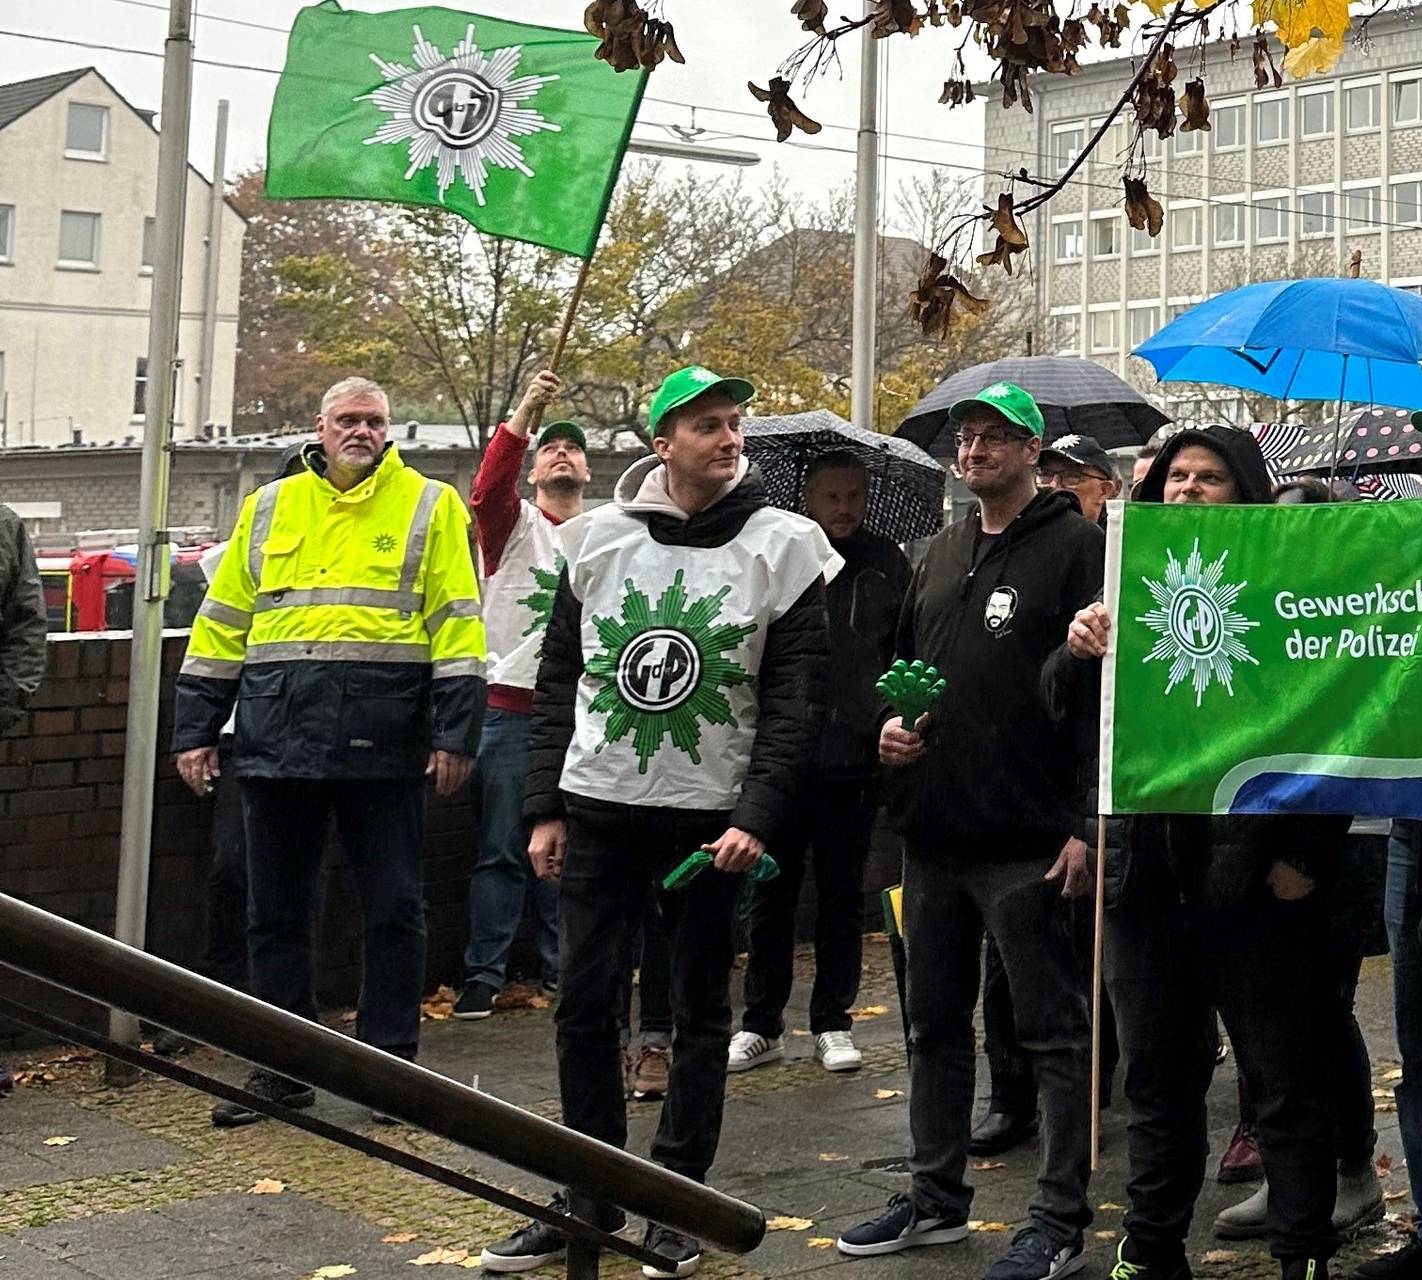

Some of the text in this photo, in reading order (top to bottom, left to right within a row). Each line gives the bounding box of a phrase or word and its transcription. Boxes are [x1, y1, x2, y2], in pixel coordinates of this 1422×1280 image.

[1177, 598, 1214, 647] GdP
[1285, 624, 1421, 660] der Polizei
[628, 640, 689, 699] GdP
